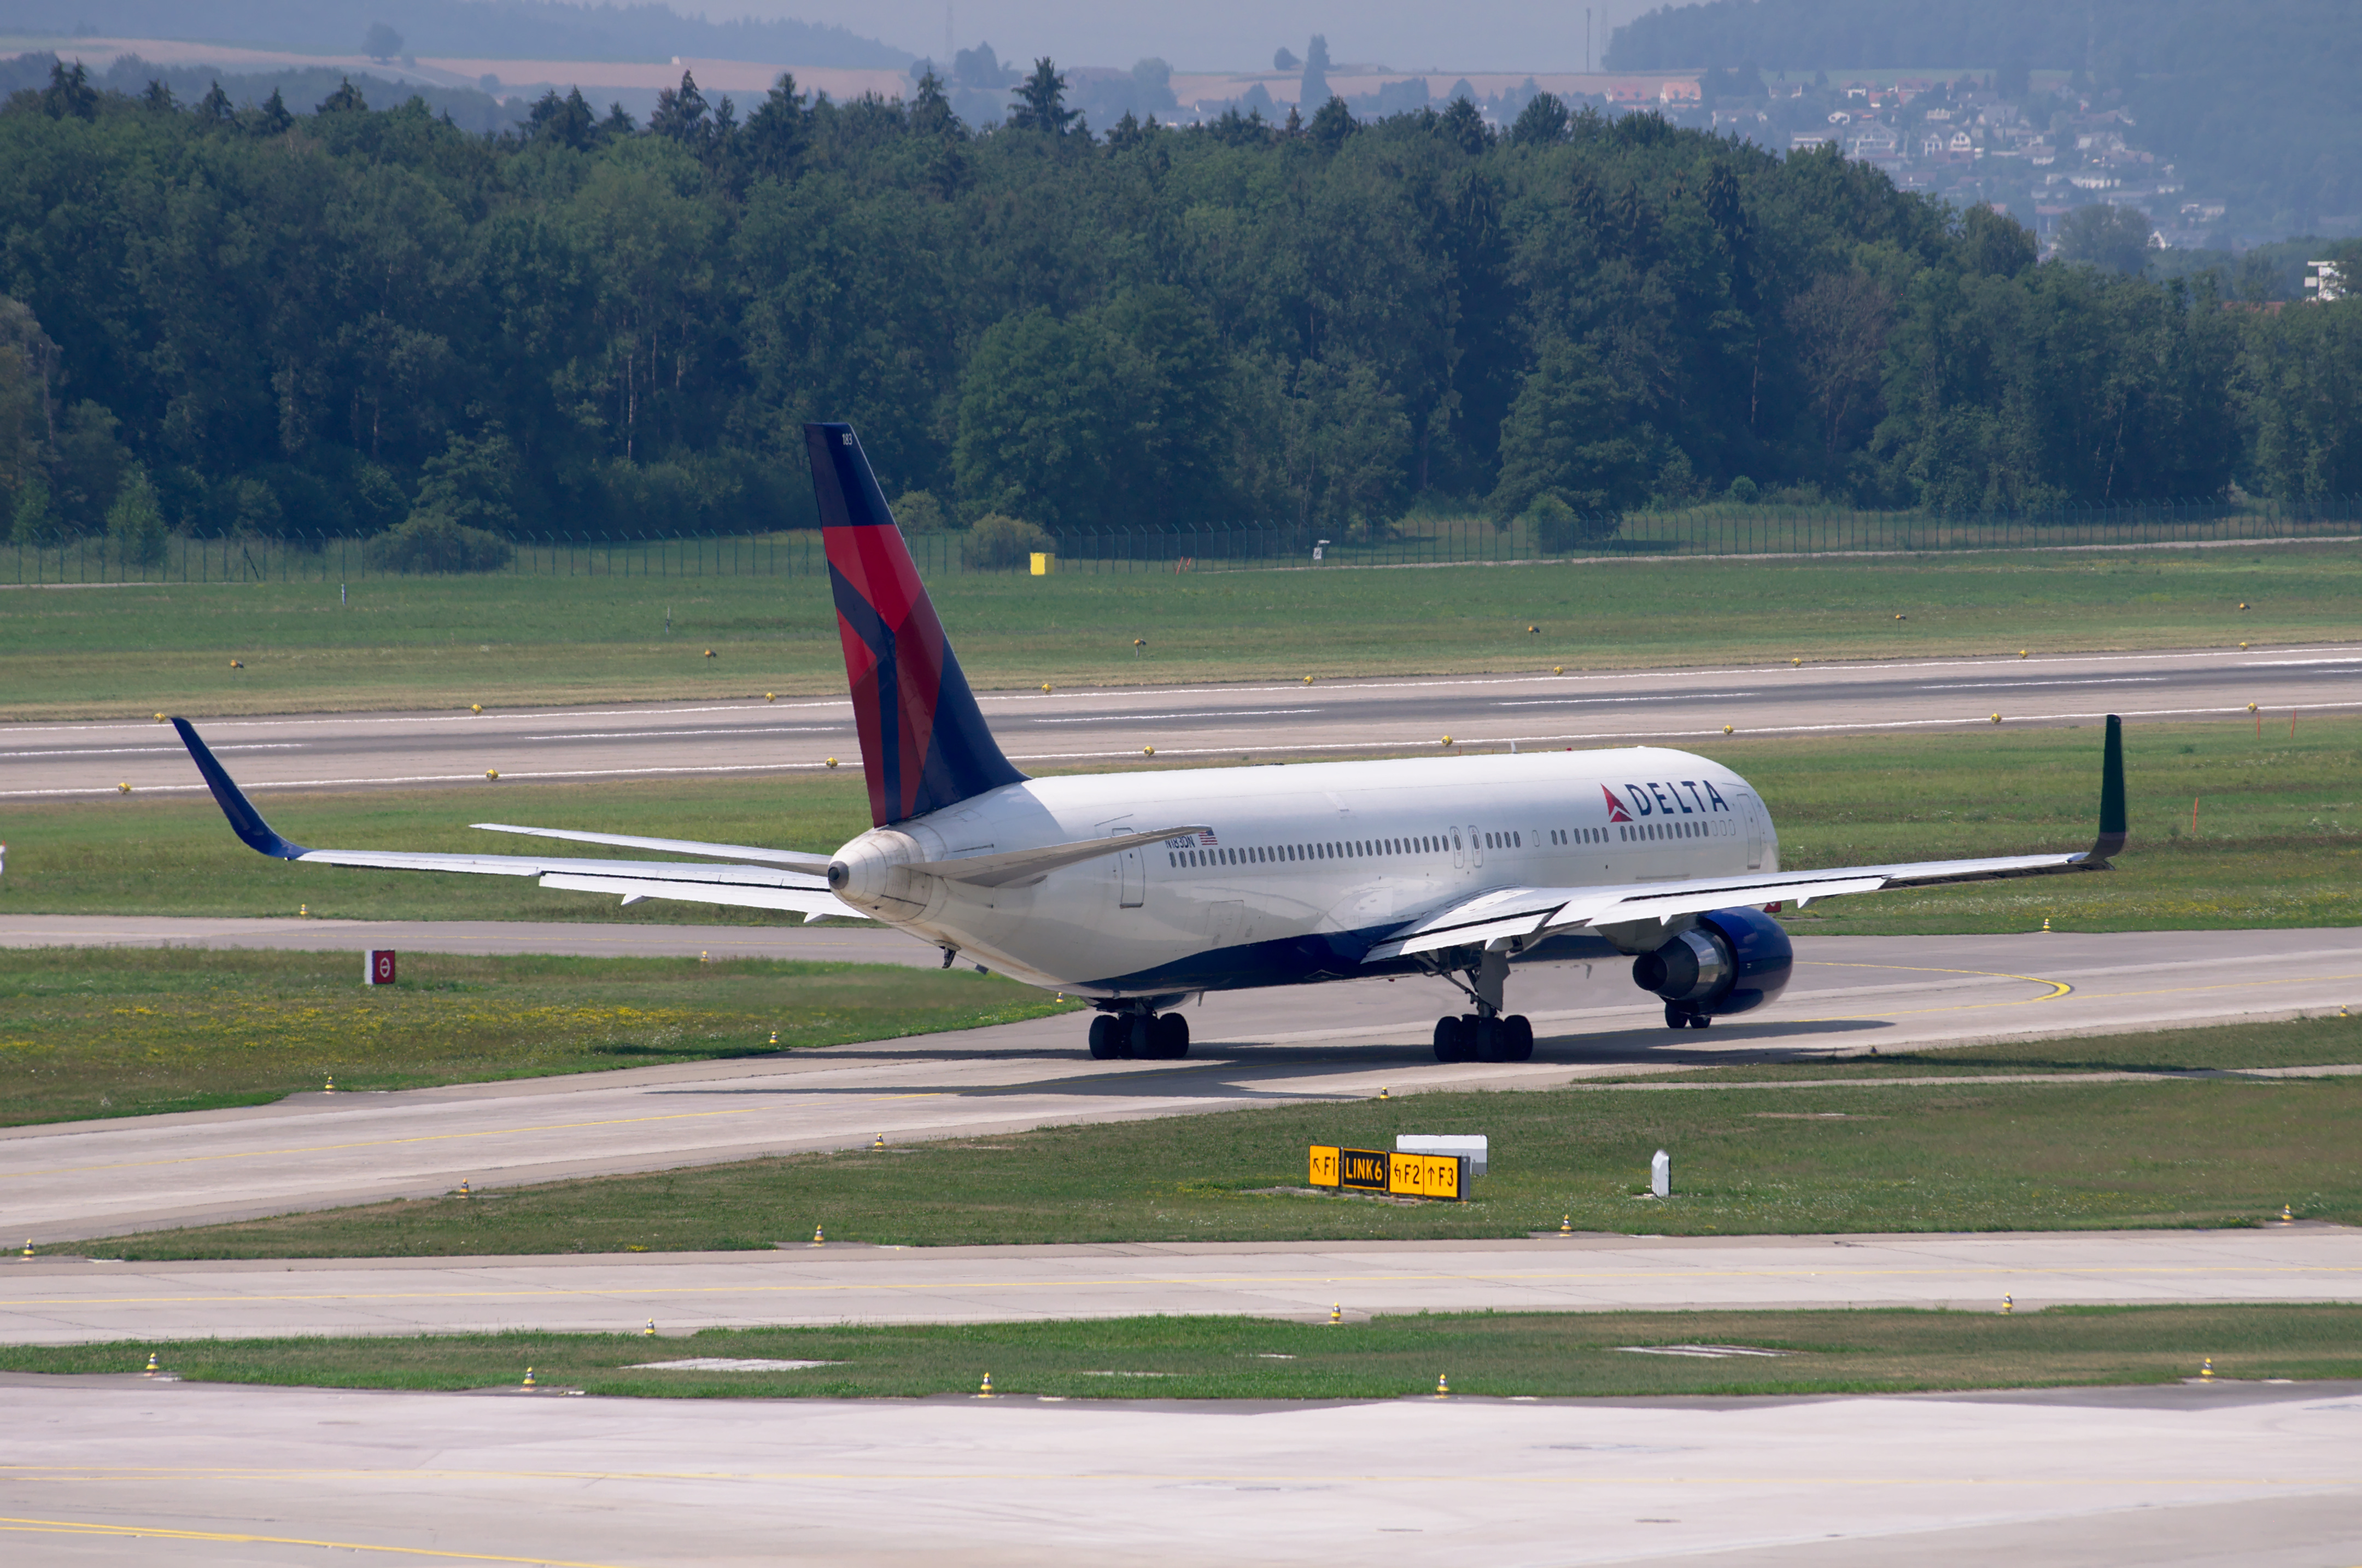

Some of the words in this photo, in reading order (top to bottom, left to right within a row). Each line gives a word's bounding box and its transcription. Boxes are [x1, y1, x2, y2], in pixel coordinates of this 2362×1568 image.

[842, 434, 852, 445] 183
[1624, 780, 1729, 816] DELTA
[1165, 835, 1195, 849] N183DN
[1324, 1157, 1335, 1176] F1
[1346, 1157, 1383, 1181] LINK6
[1405, 1164, 1420, 1185] F2
[1439, 1167, 1454, 1186] F3
